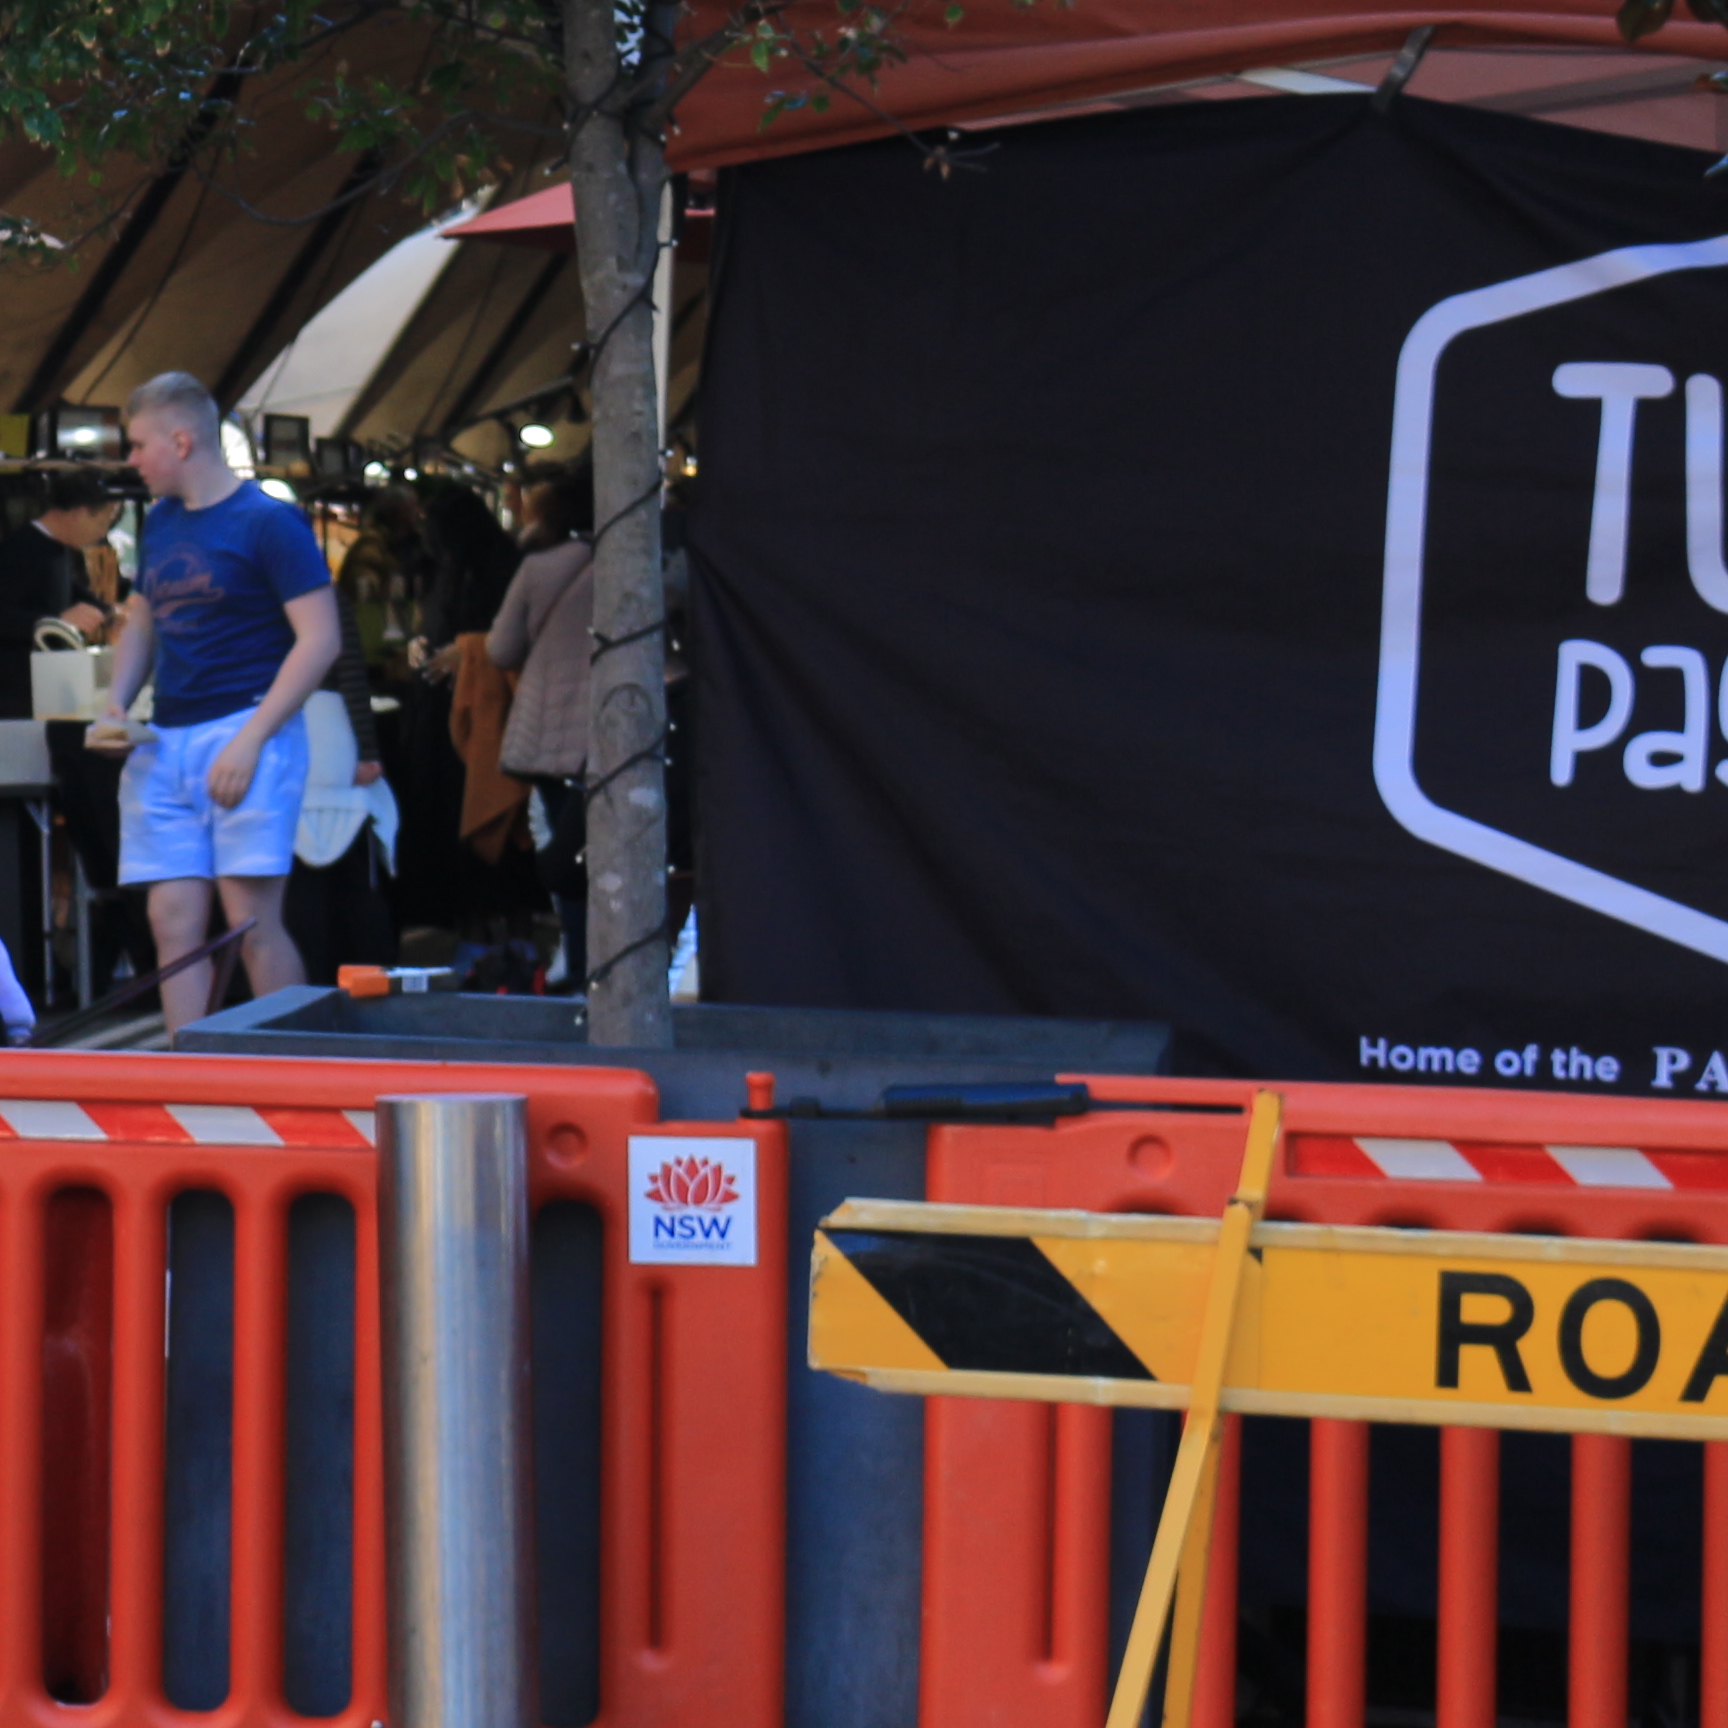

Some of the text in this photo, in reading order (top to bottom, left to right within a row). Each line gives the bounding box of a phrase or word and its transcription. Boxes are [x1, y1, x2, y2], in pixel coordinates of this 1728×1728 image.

[1359, 1036, 1728, 1093] Home of the PA
[653, 1215, 732, 1239] NSW
